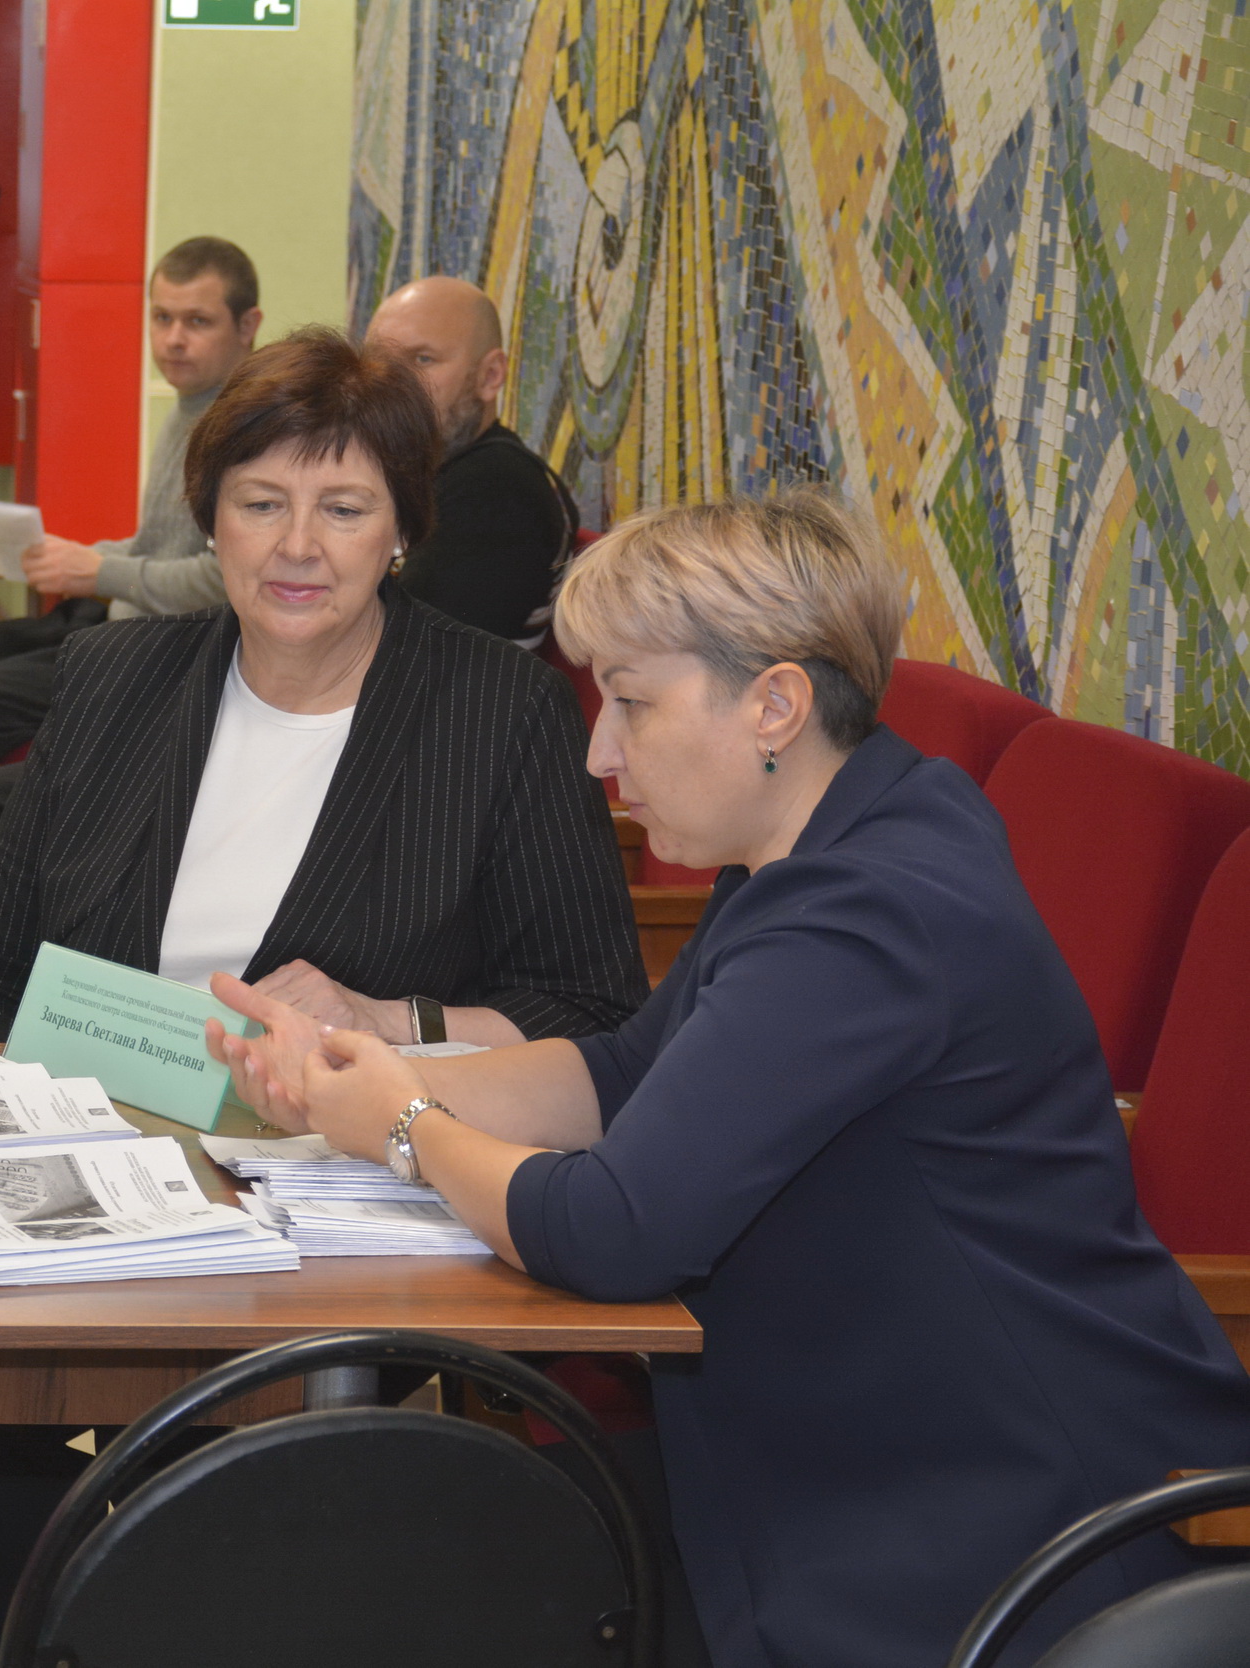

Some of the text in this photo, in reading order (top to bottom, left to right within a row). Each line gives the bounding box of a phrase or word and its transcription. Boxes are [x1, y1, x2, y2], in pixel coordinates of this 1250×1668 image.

[39, 1005, 206, 1073] Закрева Светлана Валерьевна
